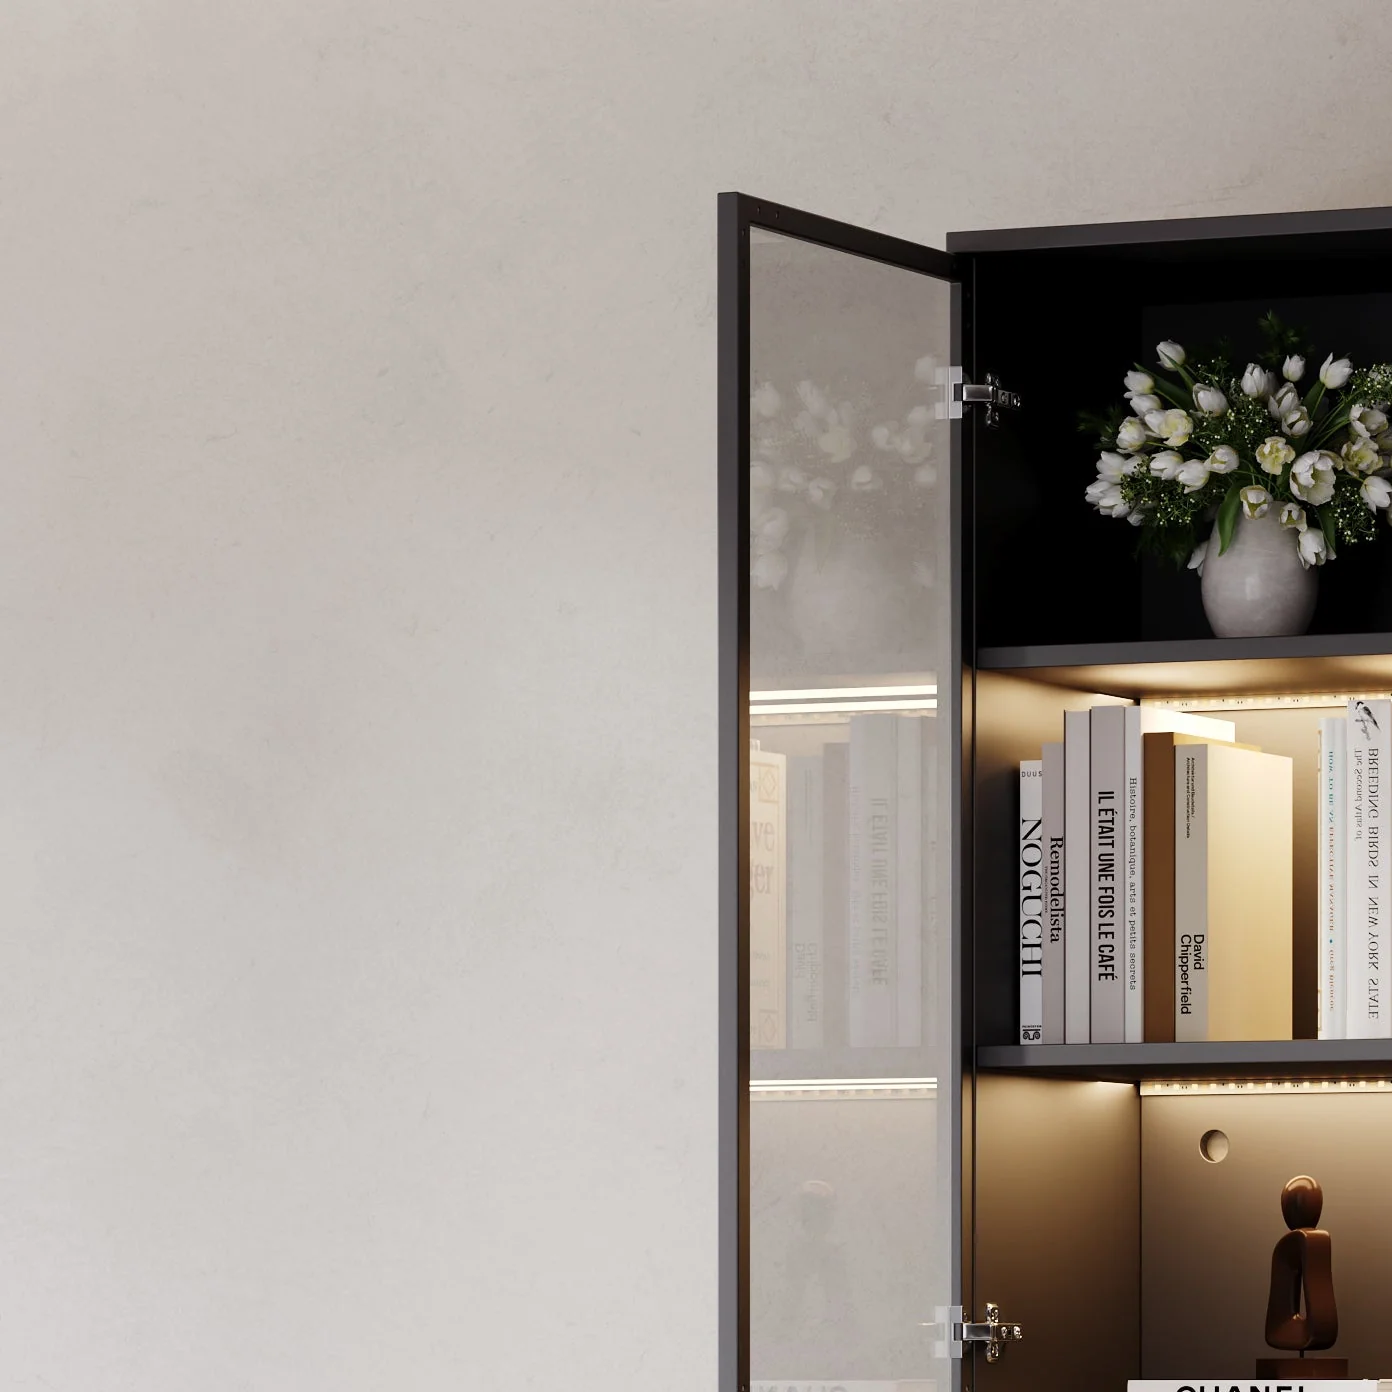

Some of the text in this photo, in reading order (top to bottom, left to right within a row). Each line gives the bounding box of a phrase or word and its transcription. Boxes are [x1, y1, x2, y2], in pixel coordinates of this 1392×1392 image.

[1021, 817, 1043, 978] NOGUCHI
[1049, 835, 1065, 944] Remodelista
[1097, 790, 1118, 982] IL ÉTAIT UNE FOIS LE CAFÉ
[1128, 777, 1138, 991] Histoire, botanique, arts et petits secrets
[1178, 934, 1193, 1015] Chipperfield
[1193, 934, 1205, 971] David
